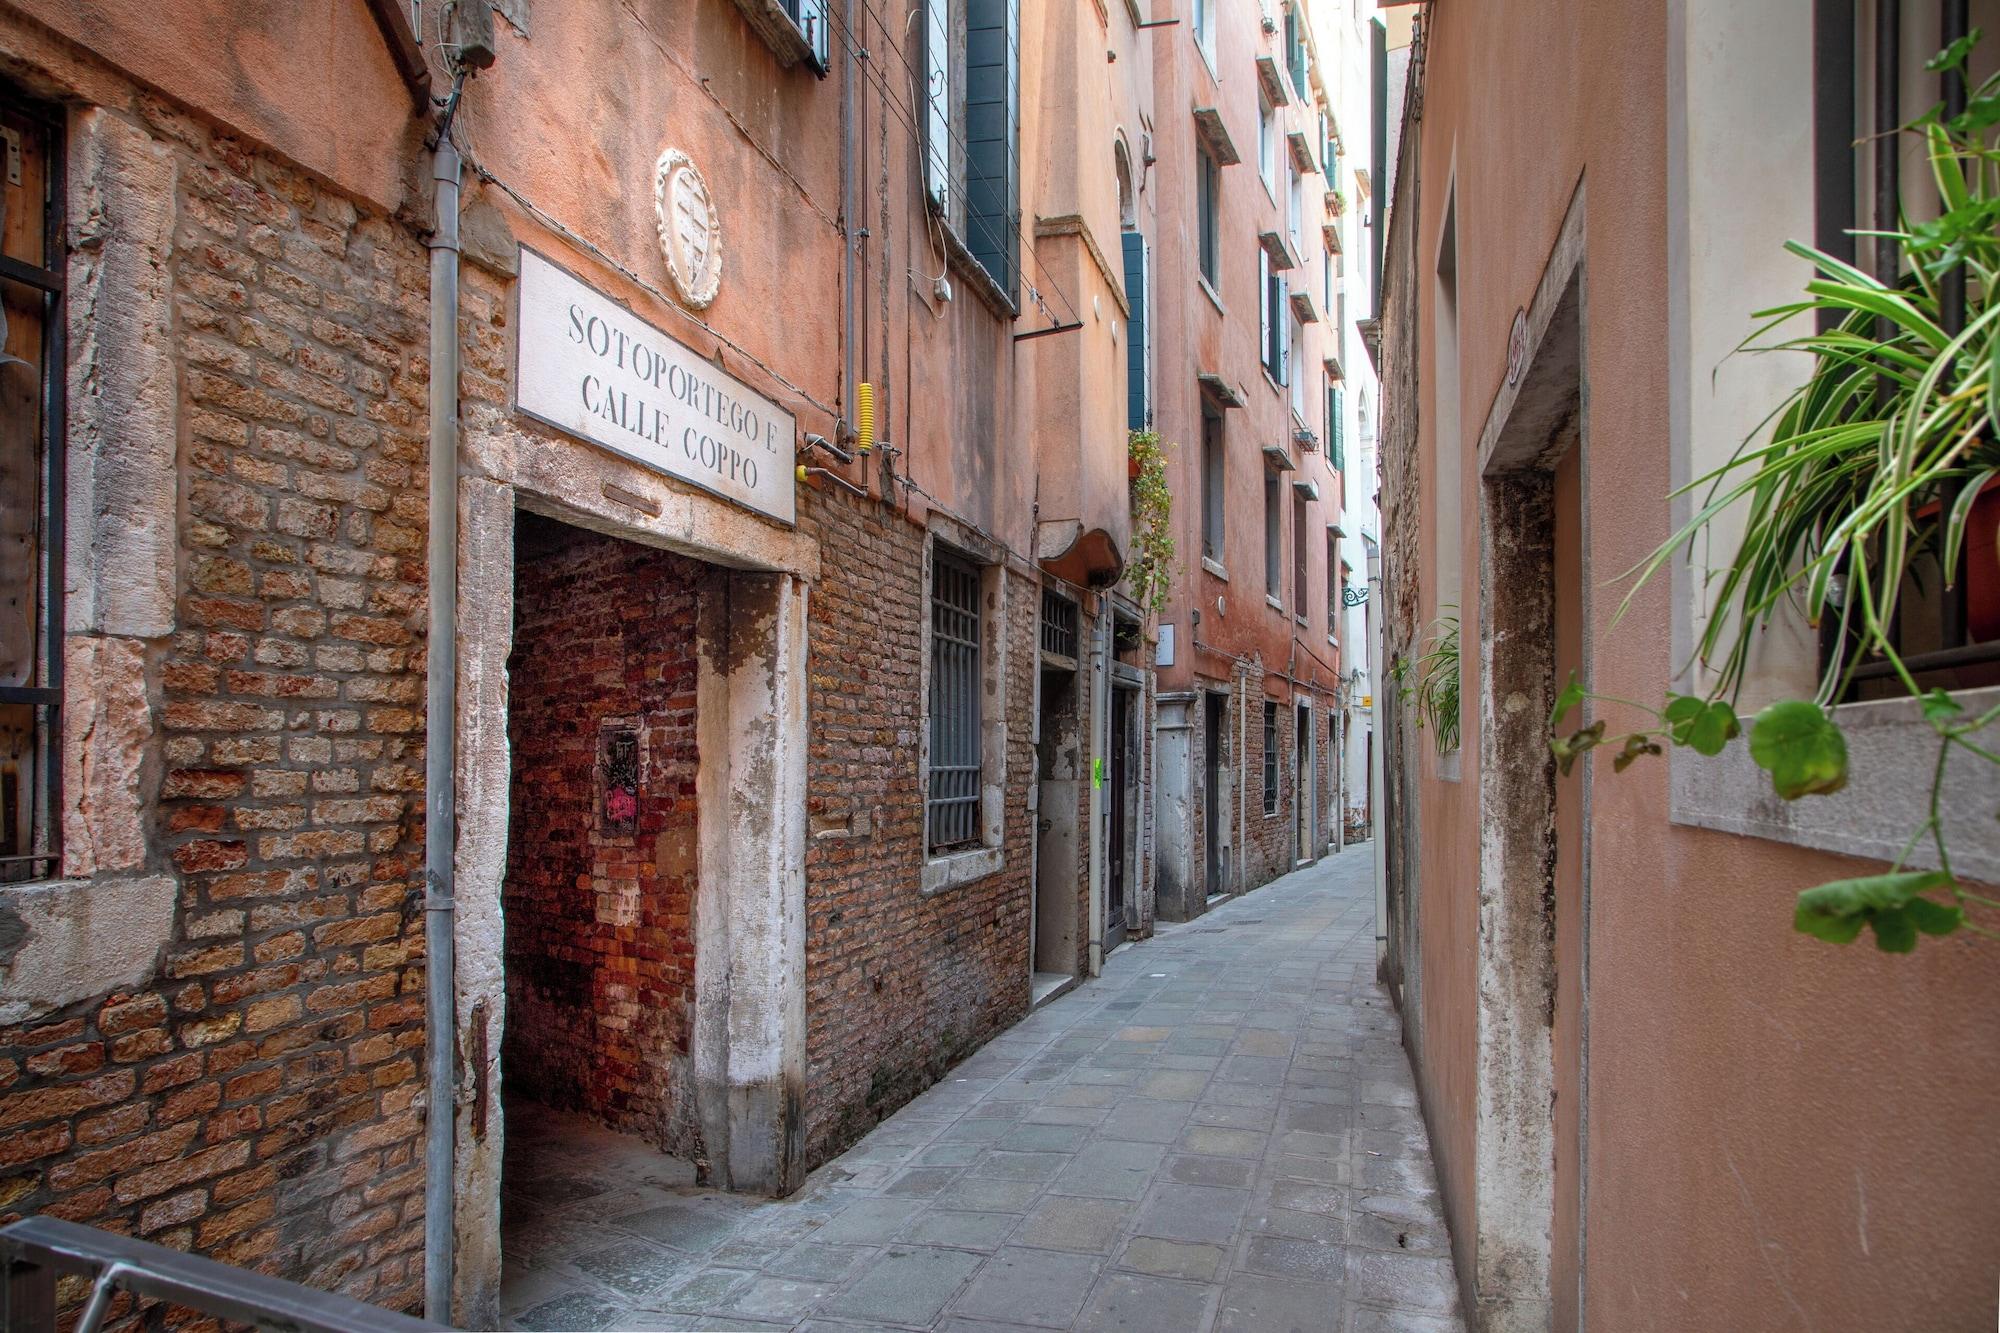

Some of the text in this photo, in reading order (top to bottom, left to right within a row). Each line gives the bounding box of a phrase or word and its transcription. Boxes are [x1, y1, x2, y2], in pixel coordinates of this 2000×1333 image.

[568, 303, 778, 455] SOTOPORTEGO E
[582, 374, 758, 490] CALLE COPPO
